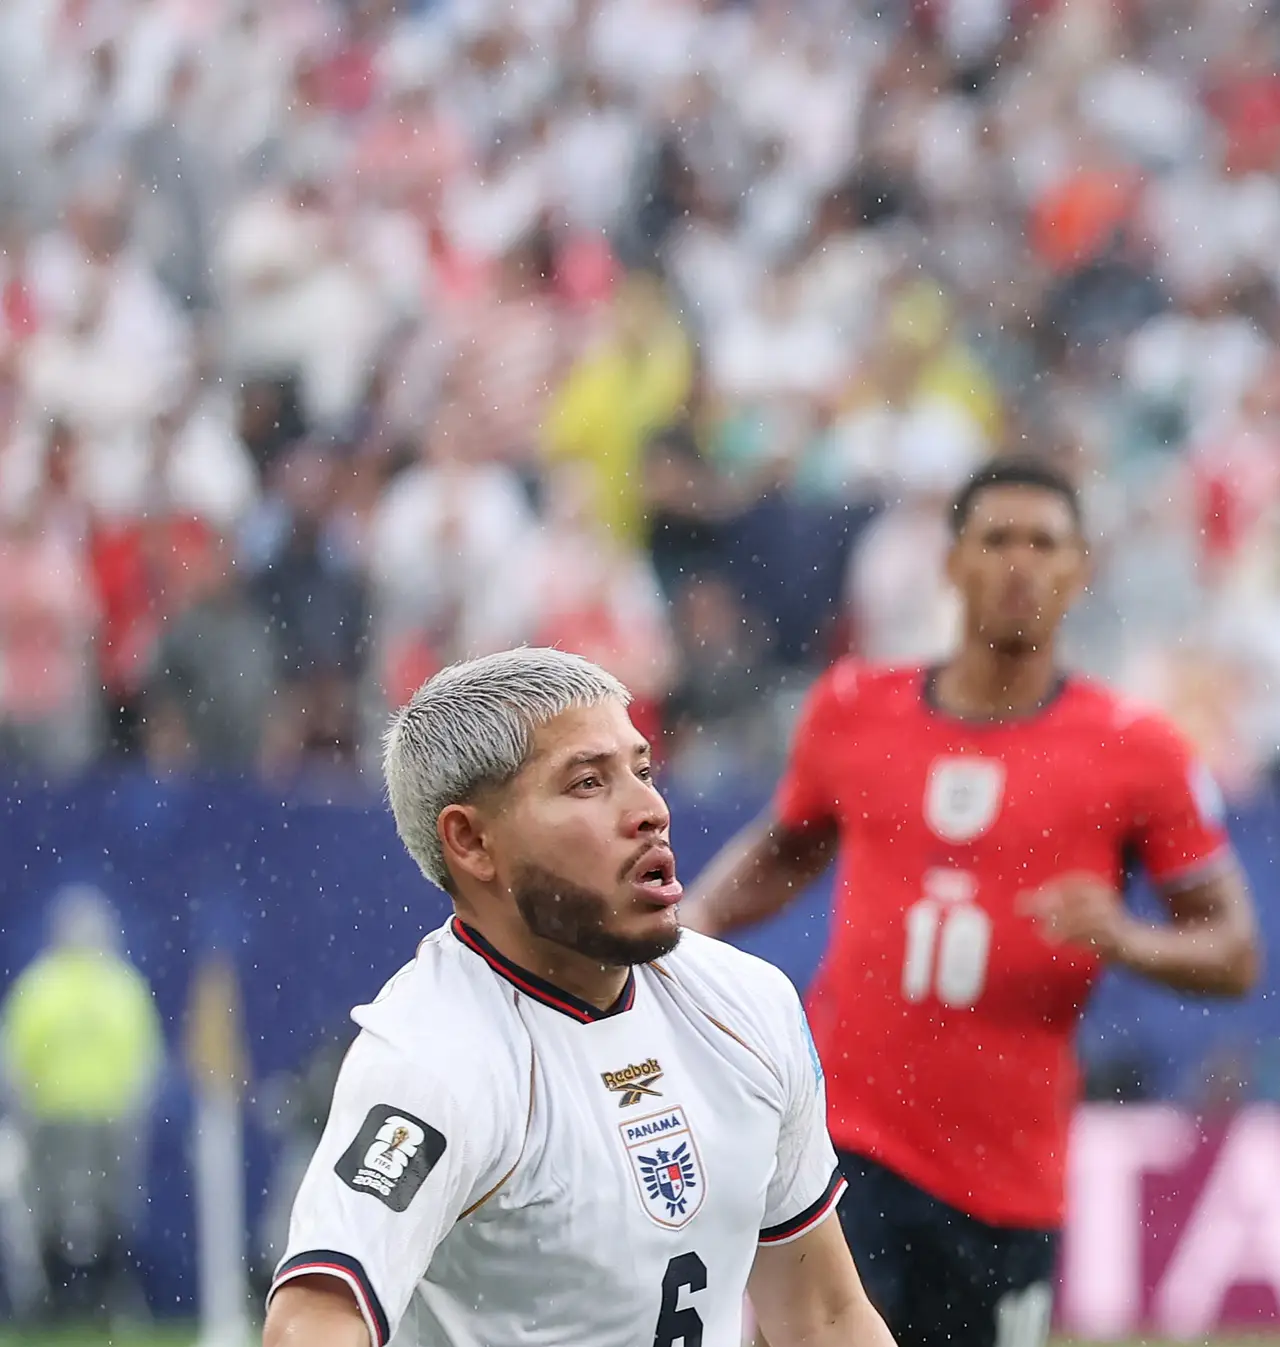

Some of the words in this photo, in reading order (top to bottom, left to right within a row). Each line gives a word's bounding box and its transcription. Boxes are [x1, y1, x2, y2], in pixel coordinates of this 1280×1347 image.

[903, 899, 991, 1008] 10
[601, 1058, 662, 1089] Reebok
[626, 1113, 682, 1140] PANAMÁ
[373, 1157, 392, 1171] FIFA
